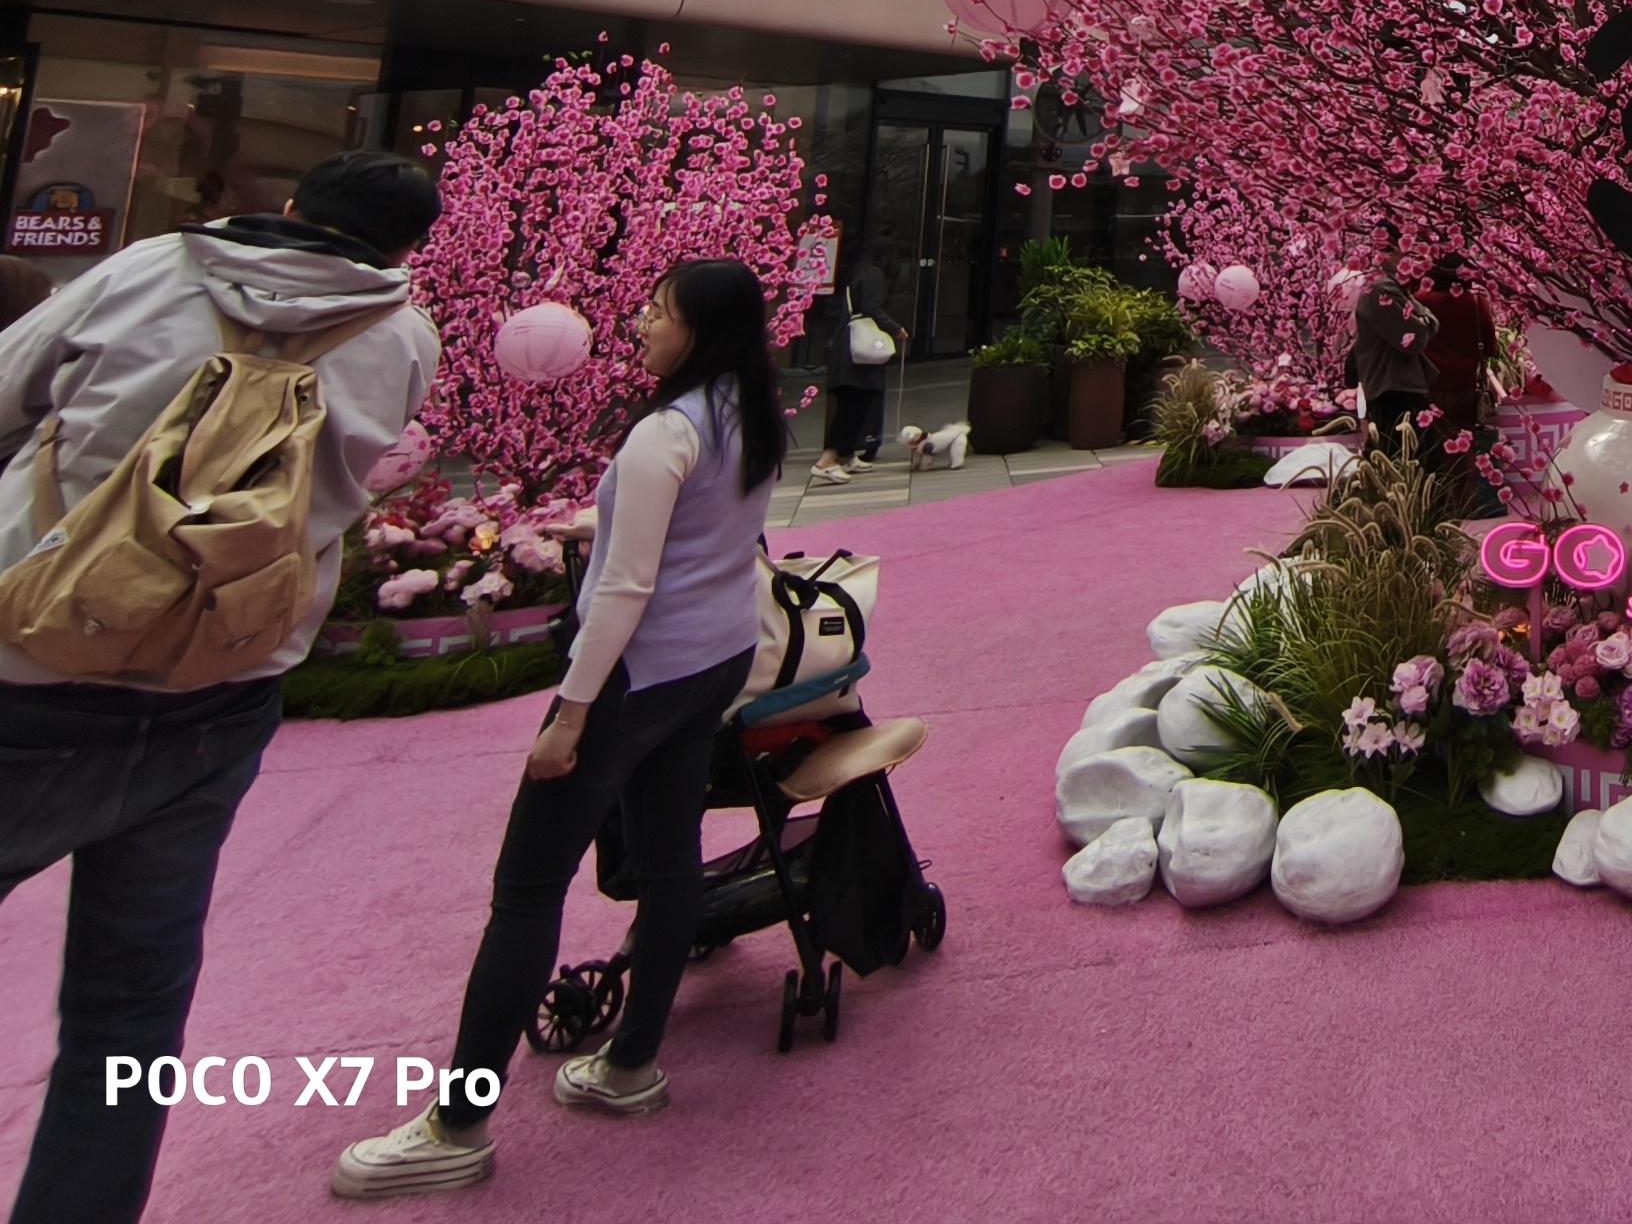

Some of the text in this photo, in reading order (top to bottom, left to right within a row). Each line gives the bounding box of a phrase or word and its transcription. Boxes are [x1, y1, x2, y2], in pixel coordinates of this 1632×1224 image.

[15, 216, 102, 230] BEARS &
[11, 232, 101, 246] FRIENDS
[1480, 522, 1625, 589] GO
